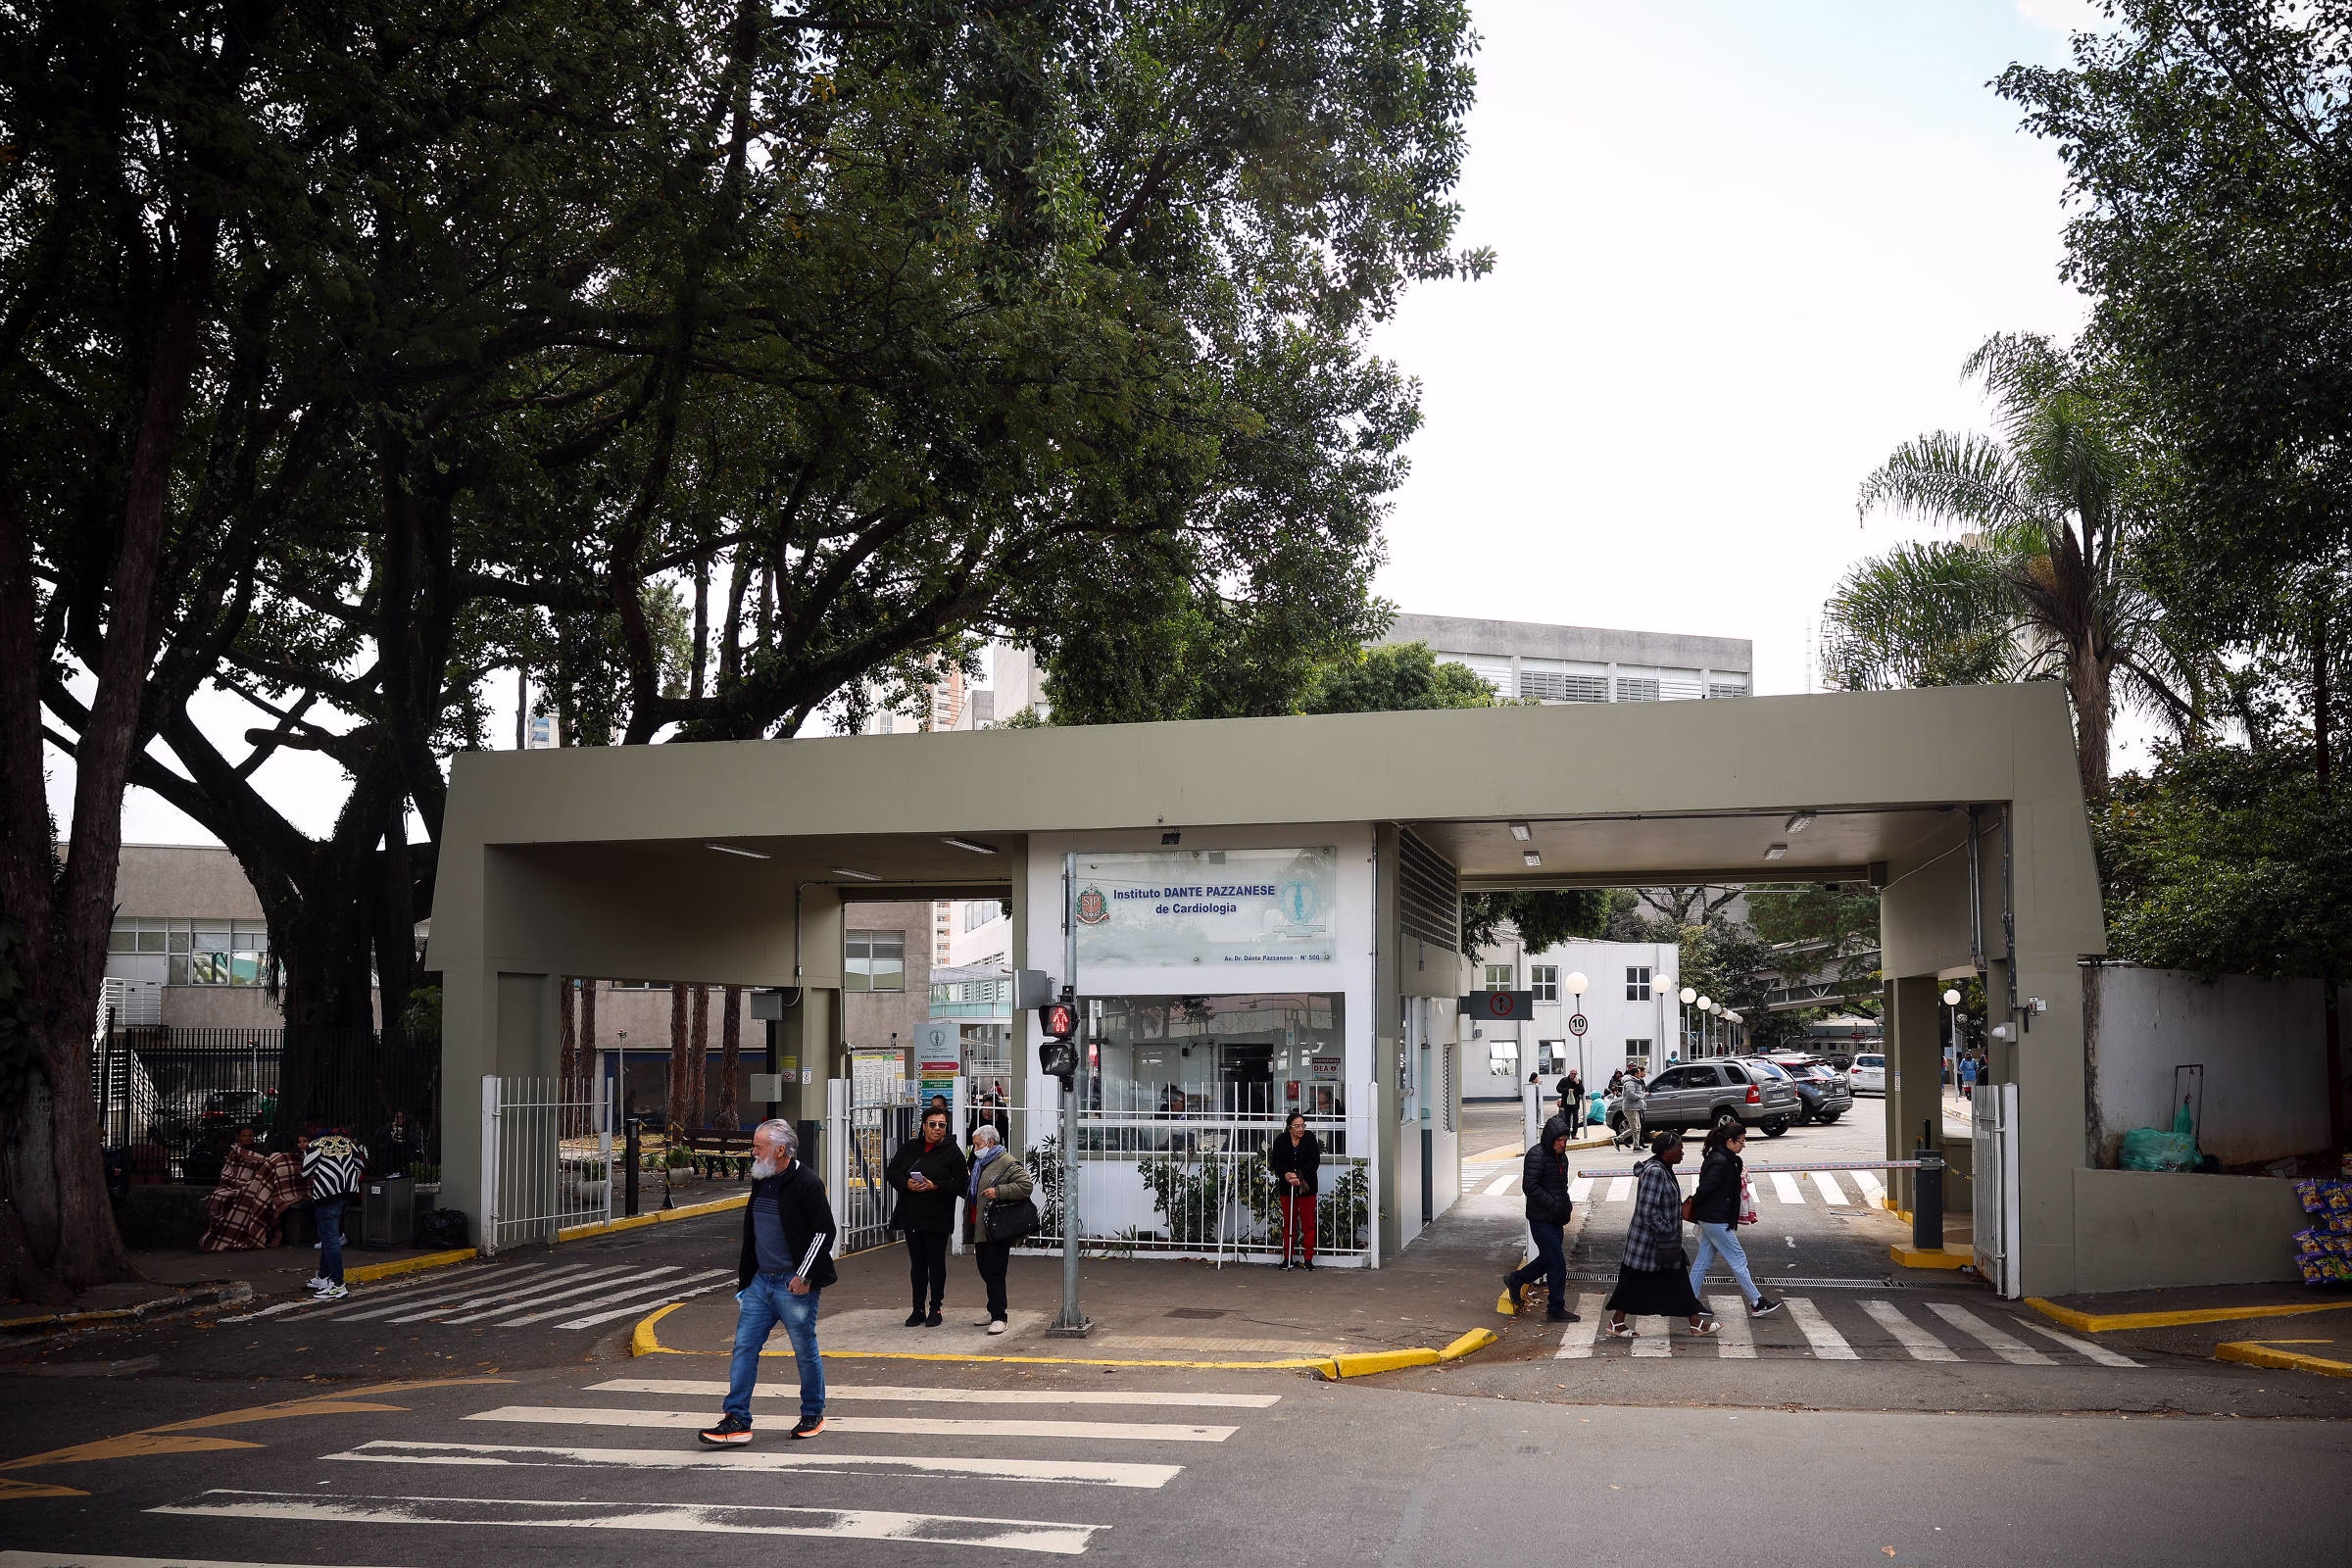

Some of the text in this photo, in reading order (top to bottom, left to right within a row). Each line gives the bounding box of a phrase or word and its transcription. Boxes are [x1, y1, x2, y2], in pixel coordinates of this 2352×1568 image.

[1113, 885, 1275, 900] Instituto DANTE PAZZANESE
[1155, 903, 1237, 915] de Cardiologia
[1572, 1018, 1585, 1028] 10
